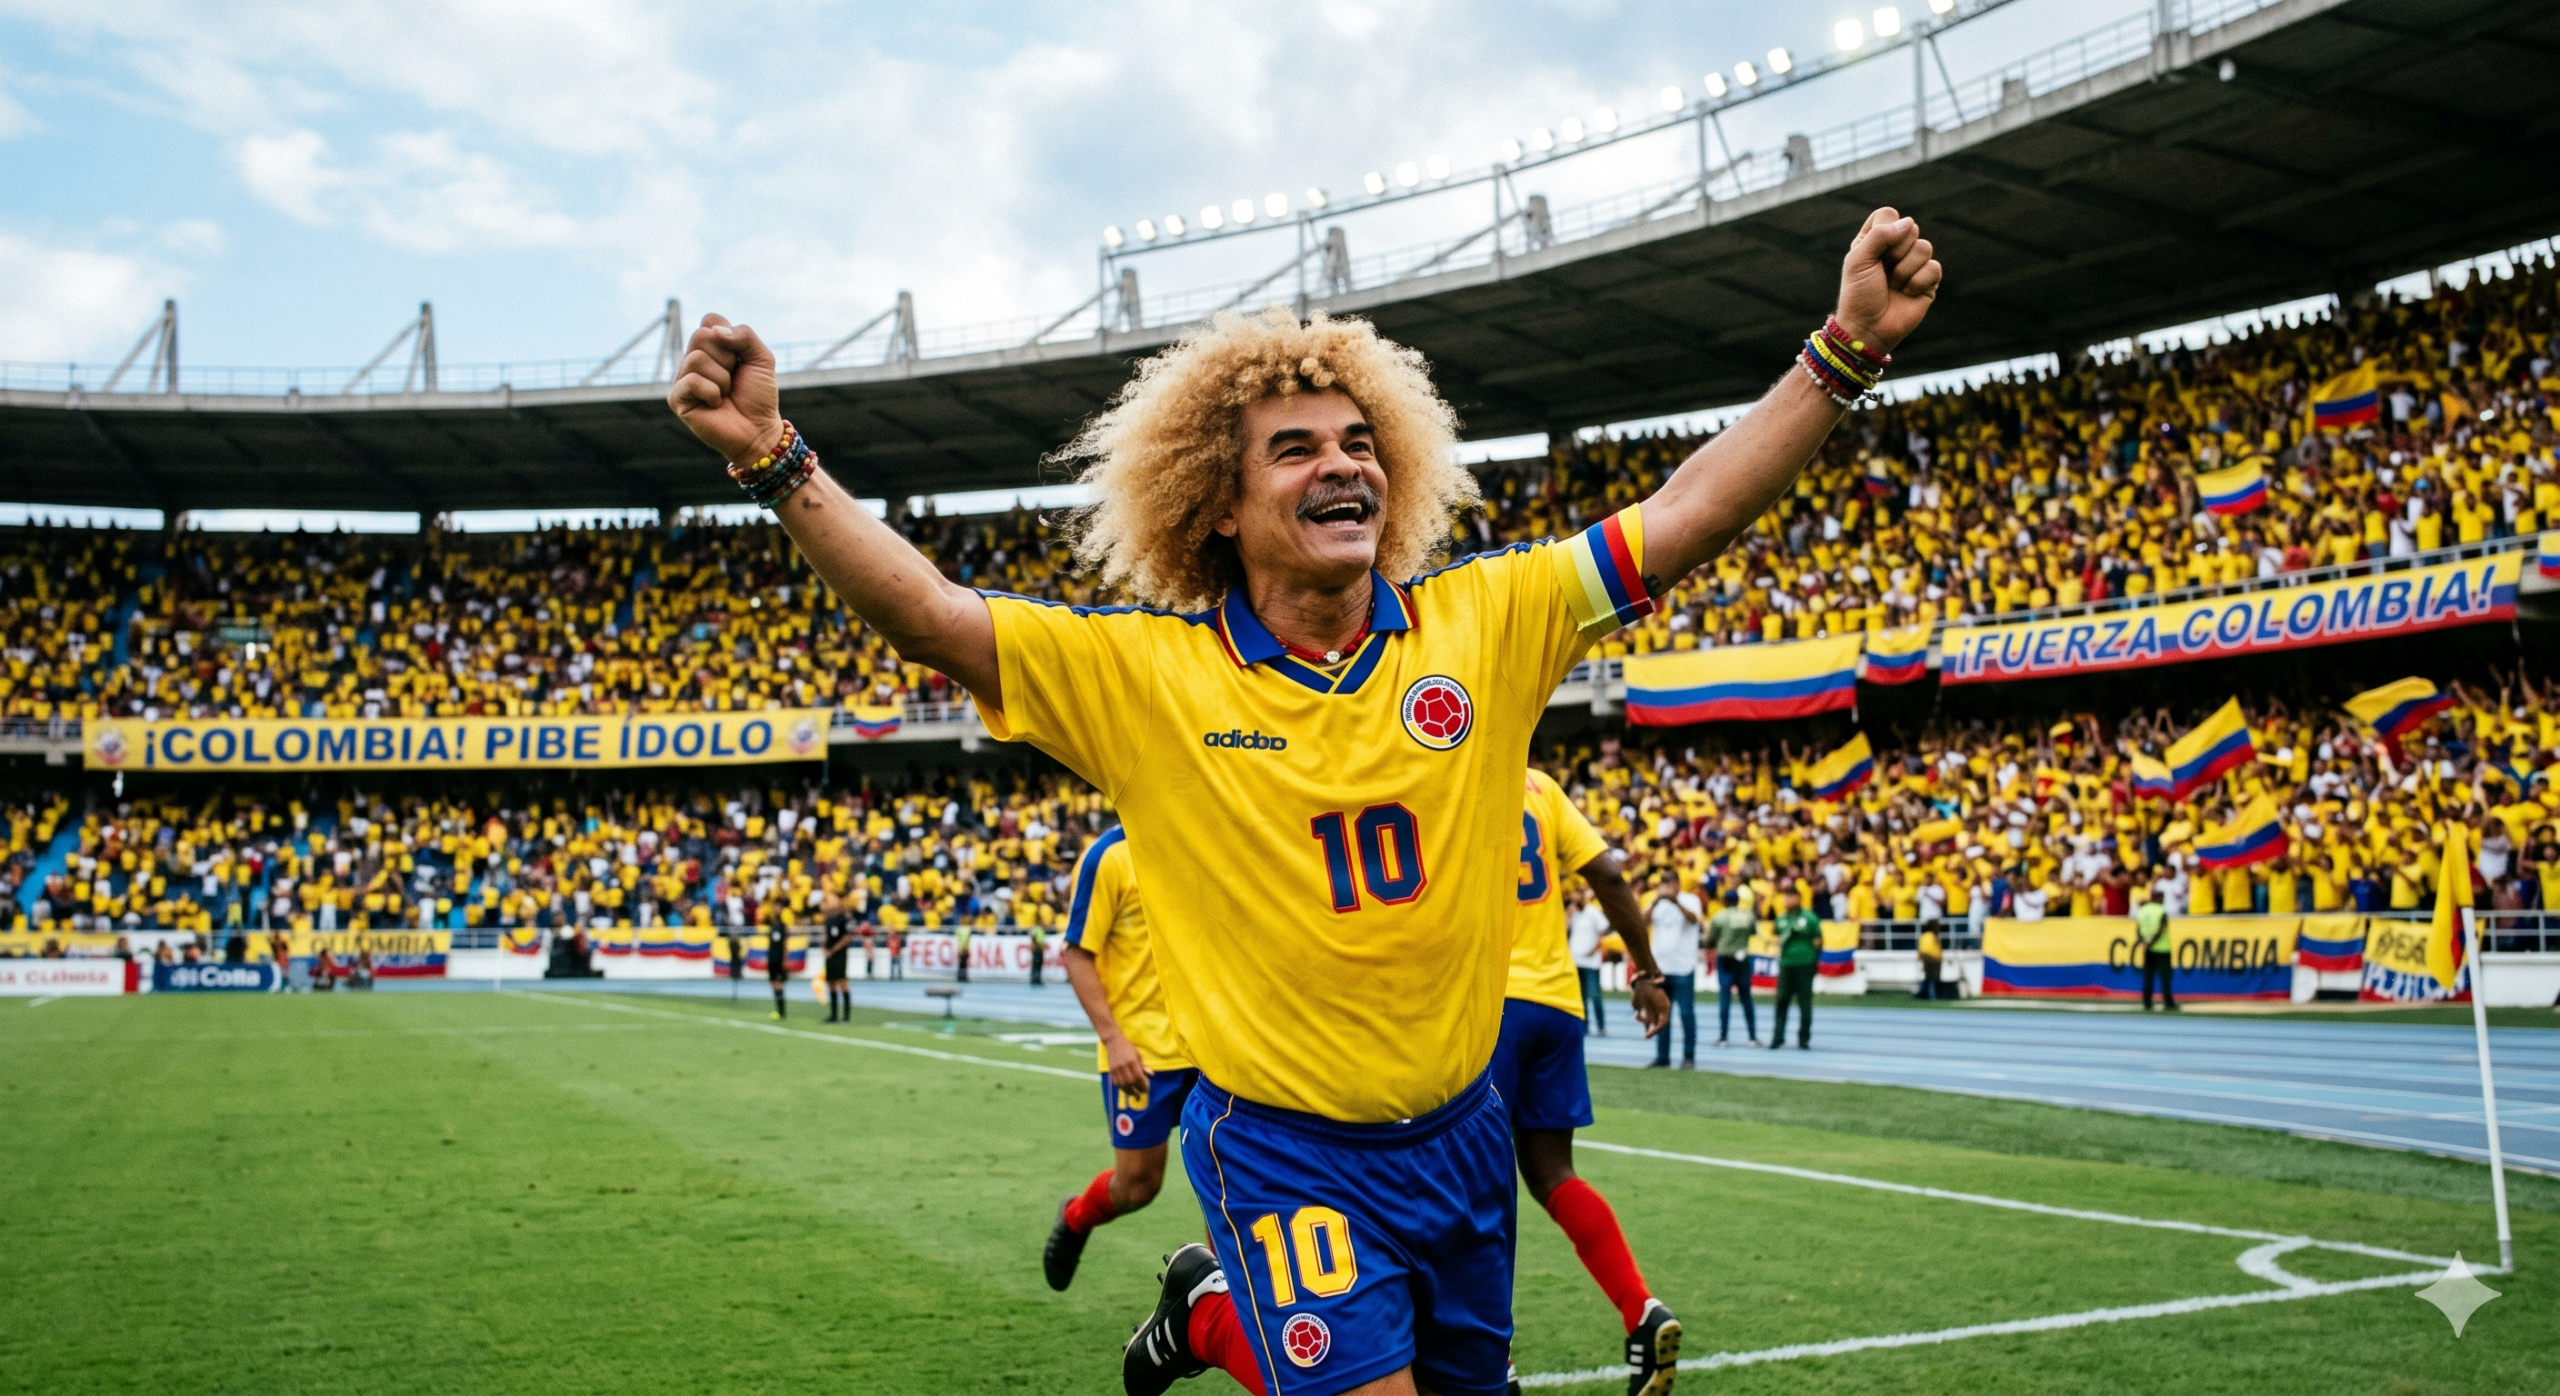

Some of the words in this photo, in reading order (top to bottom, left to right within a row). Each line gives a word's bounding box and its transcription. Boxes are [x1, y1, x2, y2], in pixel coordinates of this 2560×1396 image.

[1957, 617, 2162, 676] ¡FUERZA
[2179, 564, 2496, 651] COLOMBIA!
[145, 726, 465, 768] ¡COLOMBIA!
[485, 725, 600, 761] PIBE
[619, 715, 773, 760] ÍDOLO
[1311, 802, 1427, 914] 10
[2110, 938, 2279, 975] COOMBIA
[1250, 1205, 1358, 1307] 10
